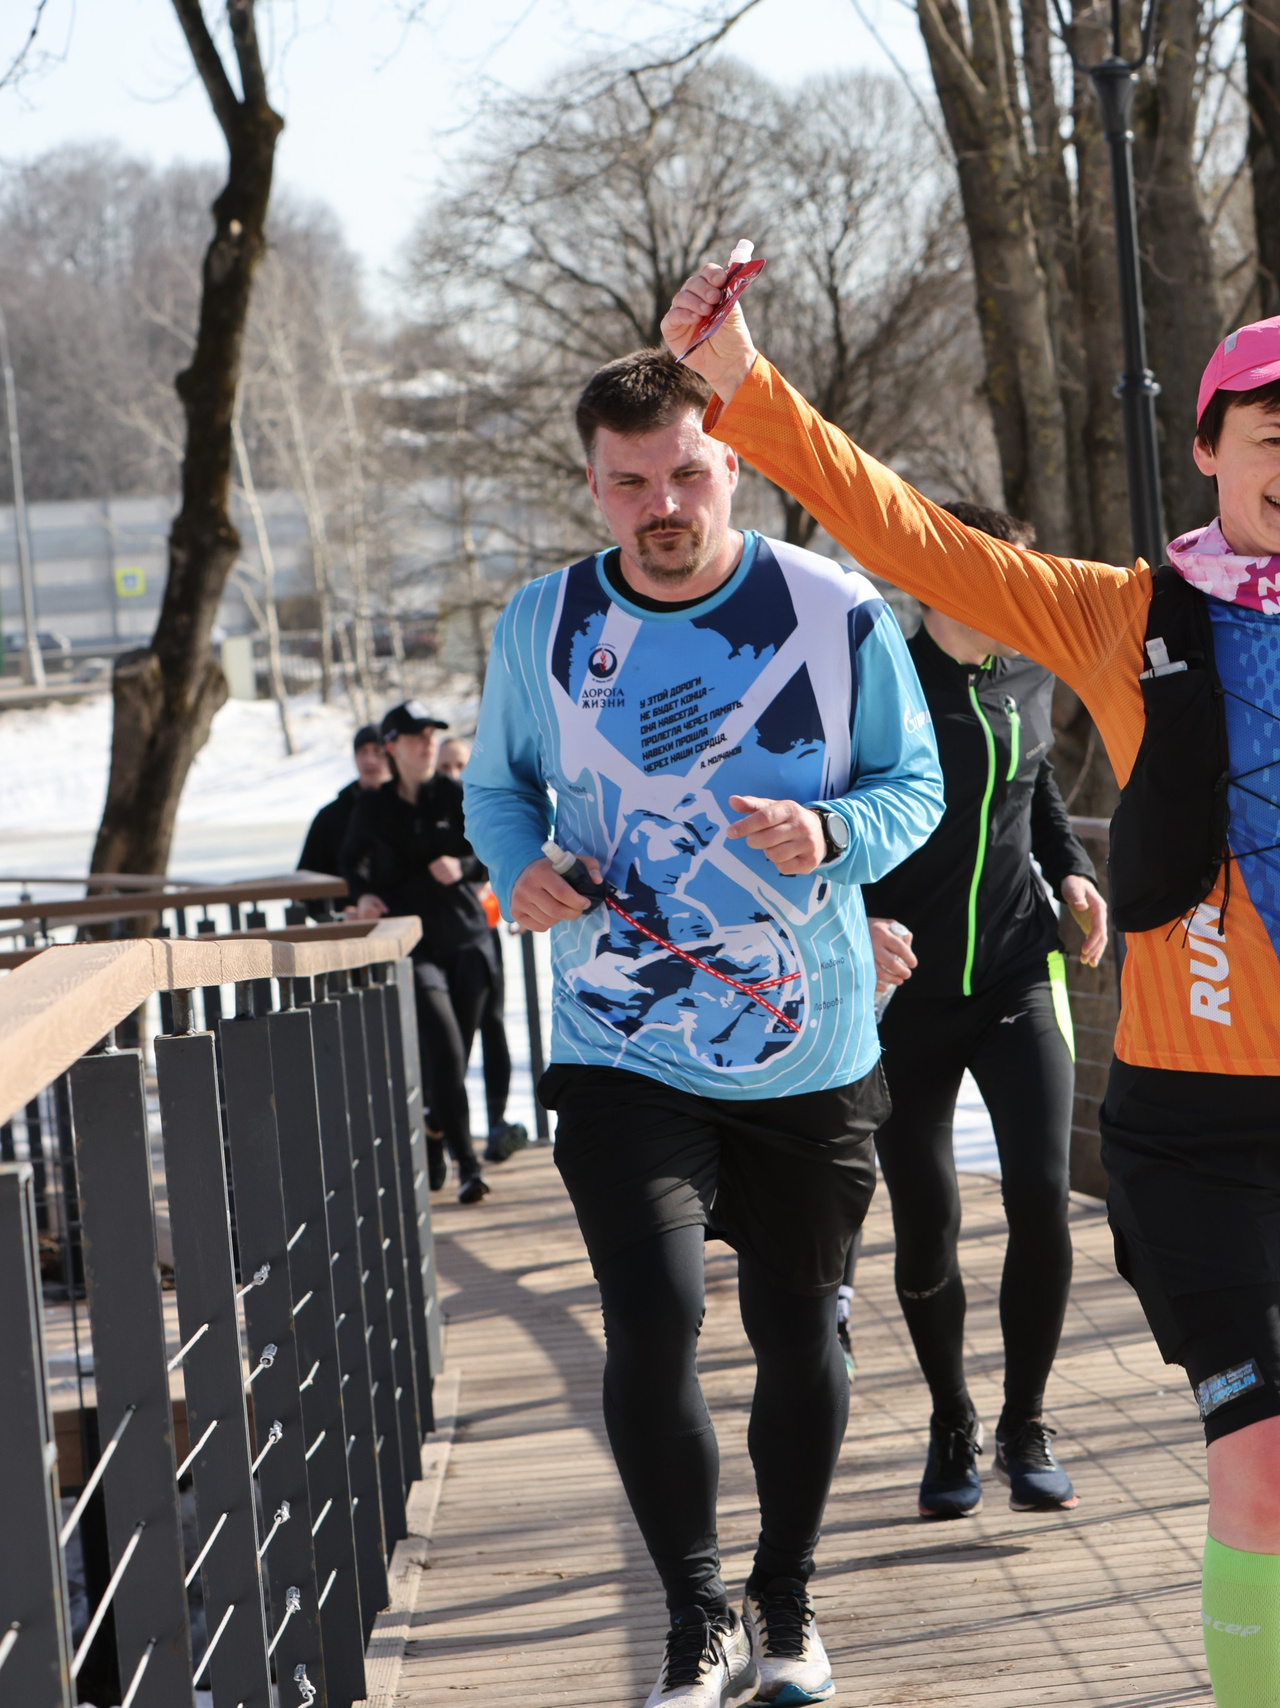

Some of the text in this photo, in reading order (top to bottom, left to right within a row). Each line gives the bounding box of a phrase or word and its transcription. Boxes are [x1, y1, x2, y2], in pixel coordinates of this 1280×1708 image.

[581, 687, 625, 699] ДОРОГА
[581, 698, 626, 709] ЖИЗНИ
[640, 676, 702, 709] У ЭТОЙ ДОРОГИ
[640, 710, 651, 722] НЕ
[652, 699, 679, 718] БУДЕТ
[680, 687, 707, 706] КОНЦА
[640, 704, 699, 735] ОНА НАВСЕГДА
[641, 725, 682, 748] ПРОЛЕГЛА
[683, 713, 709, 730] ЧЕРЕЗ
[642, 727, 708, 761] НАВЕКИ ПРОШЛА
[644, 733, 728, 773] ЧЕРЕЗ НАШИ СЕРДЦА.
[708, 745, 742, 766] МОЛЧАНОВ
[1181, 902, 1232, 1027] RUN
[1212, 1620, 1261, 1638] cep
